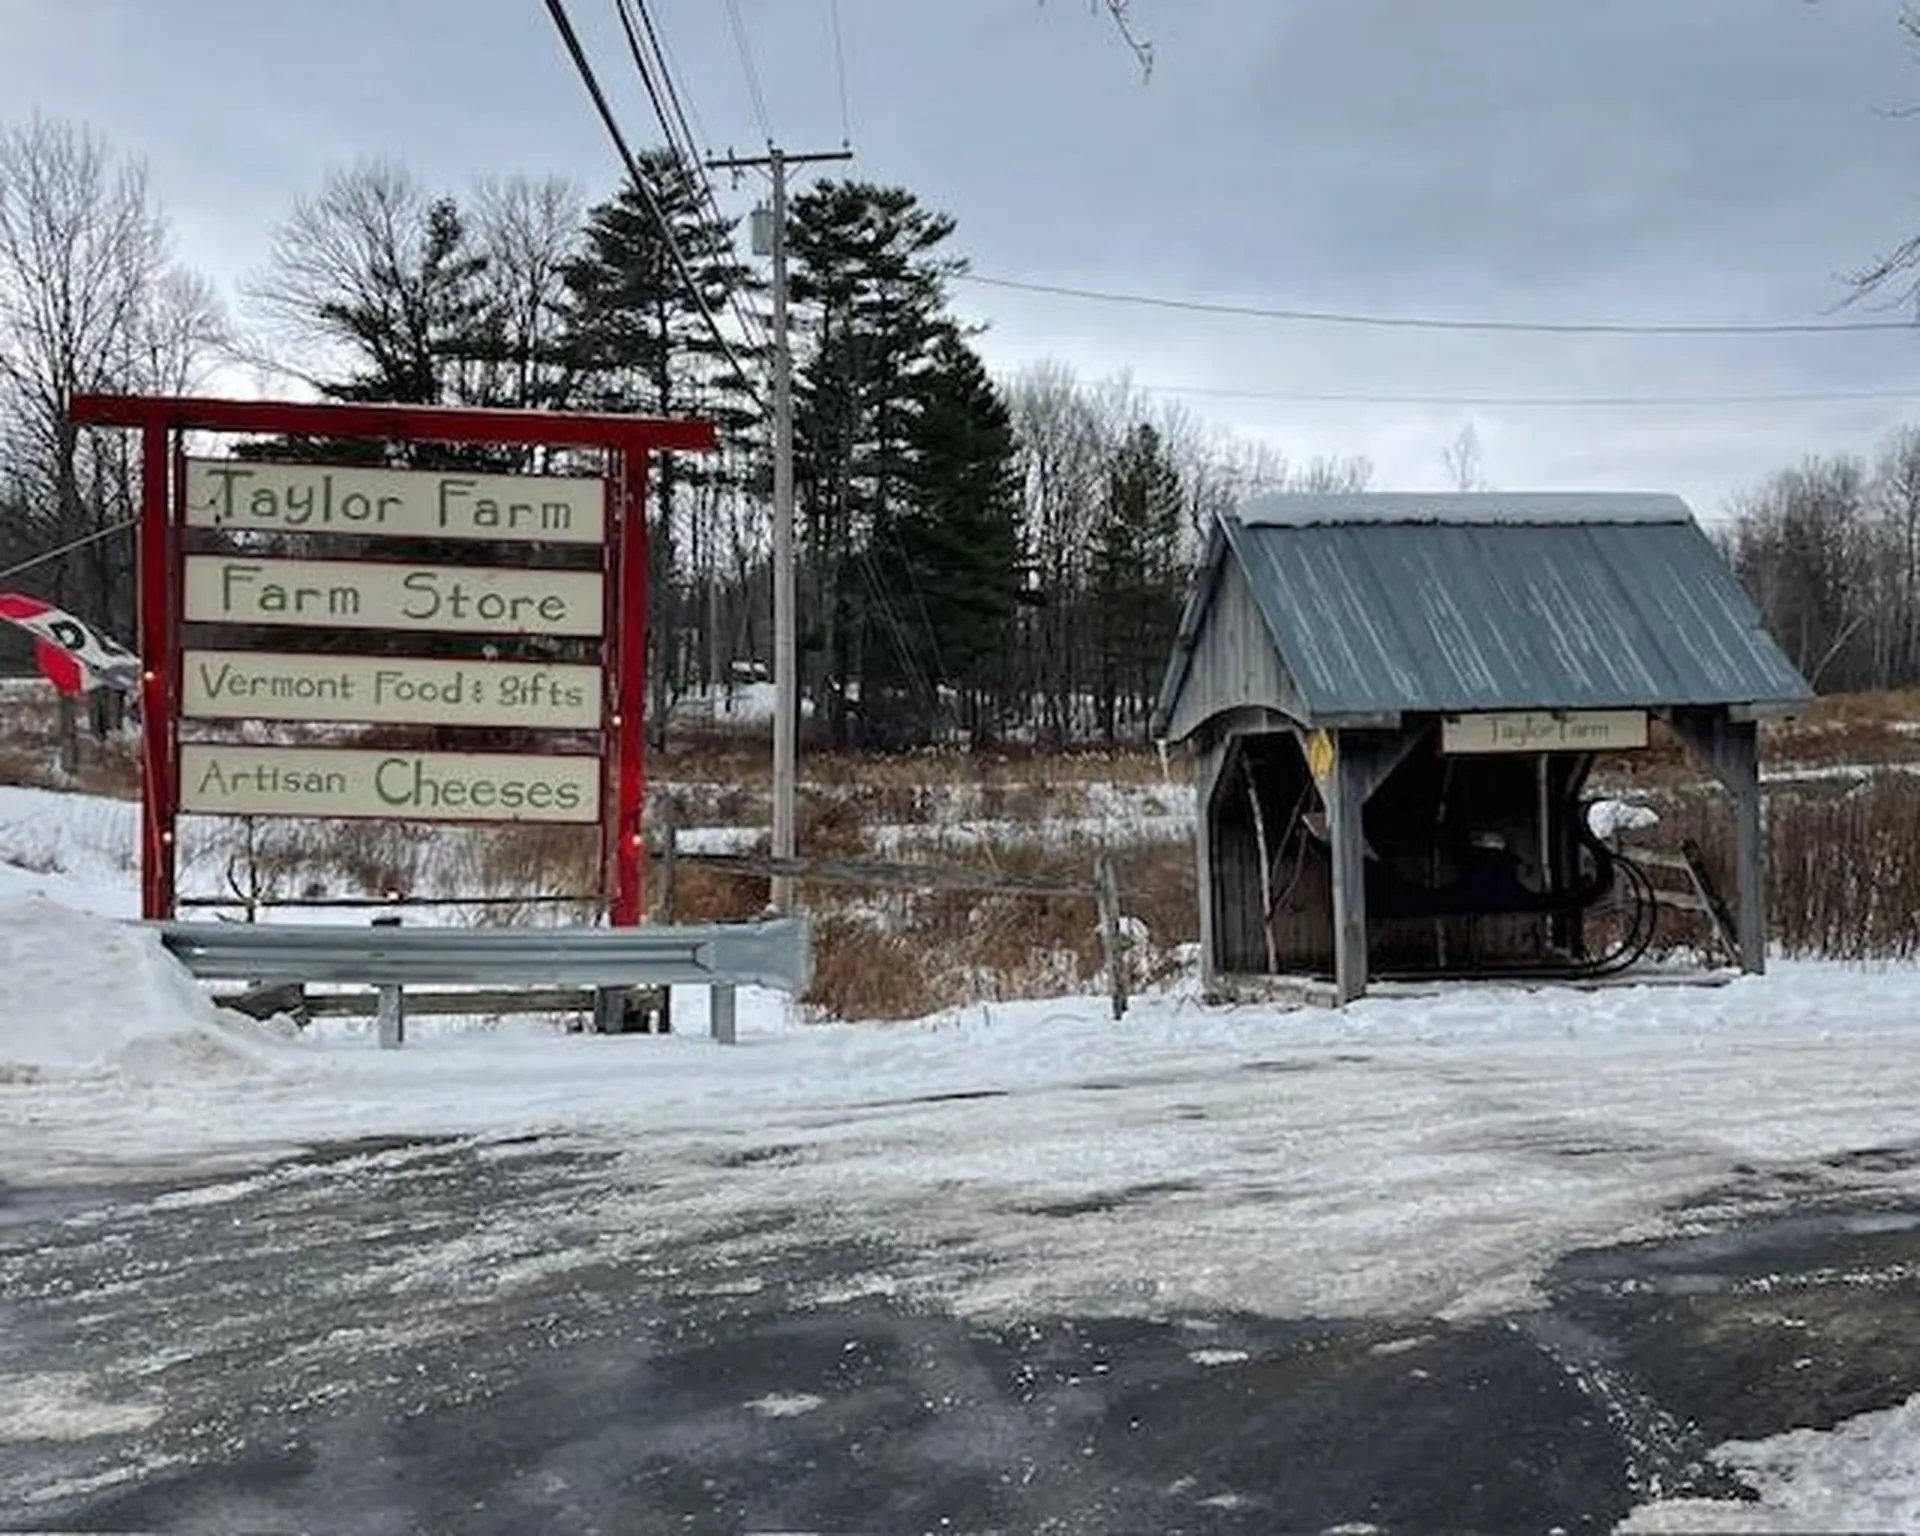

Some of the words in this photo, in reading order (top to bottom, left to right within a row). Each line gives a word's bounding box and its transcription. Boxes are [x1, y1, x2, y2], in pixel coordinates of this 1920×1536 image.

[206, 469, 402, 524] Taylor
[438, 478, 573, 530] Farm
[221, 564, 362, 615] Farm
[401, 572, 567, 621] Store
[200, 663, 356, 700] Vermont
[374, 671, 464, 706] Food
[199, 760, 346, 796] Artisan
[374, 757, 582, 810] Cheeses
